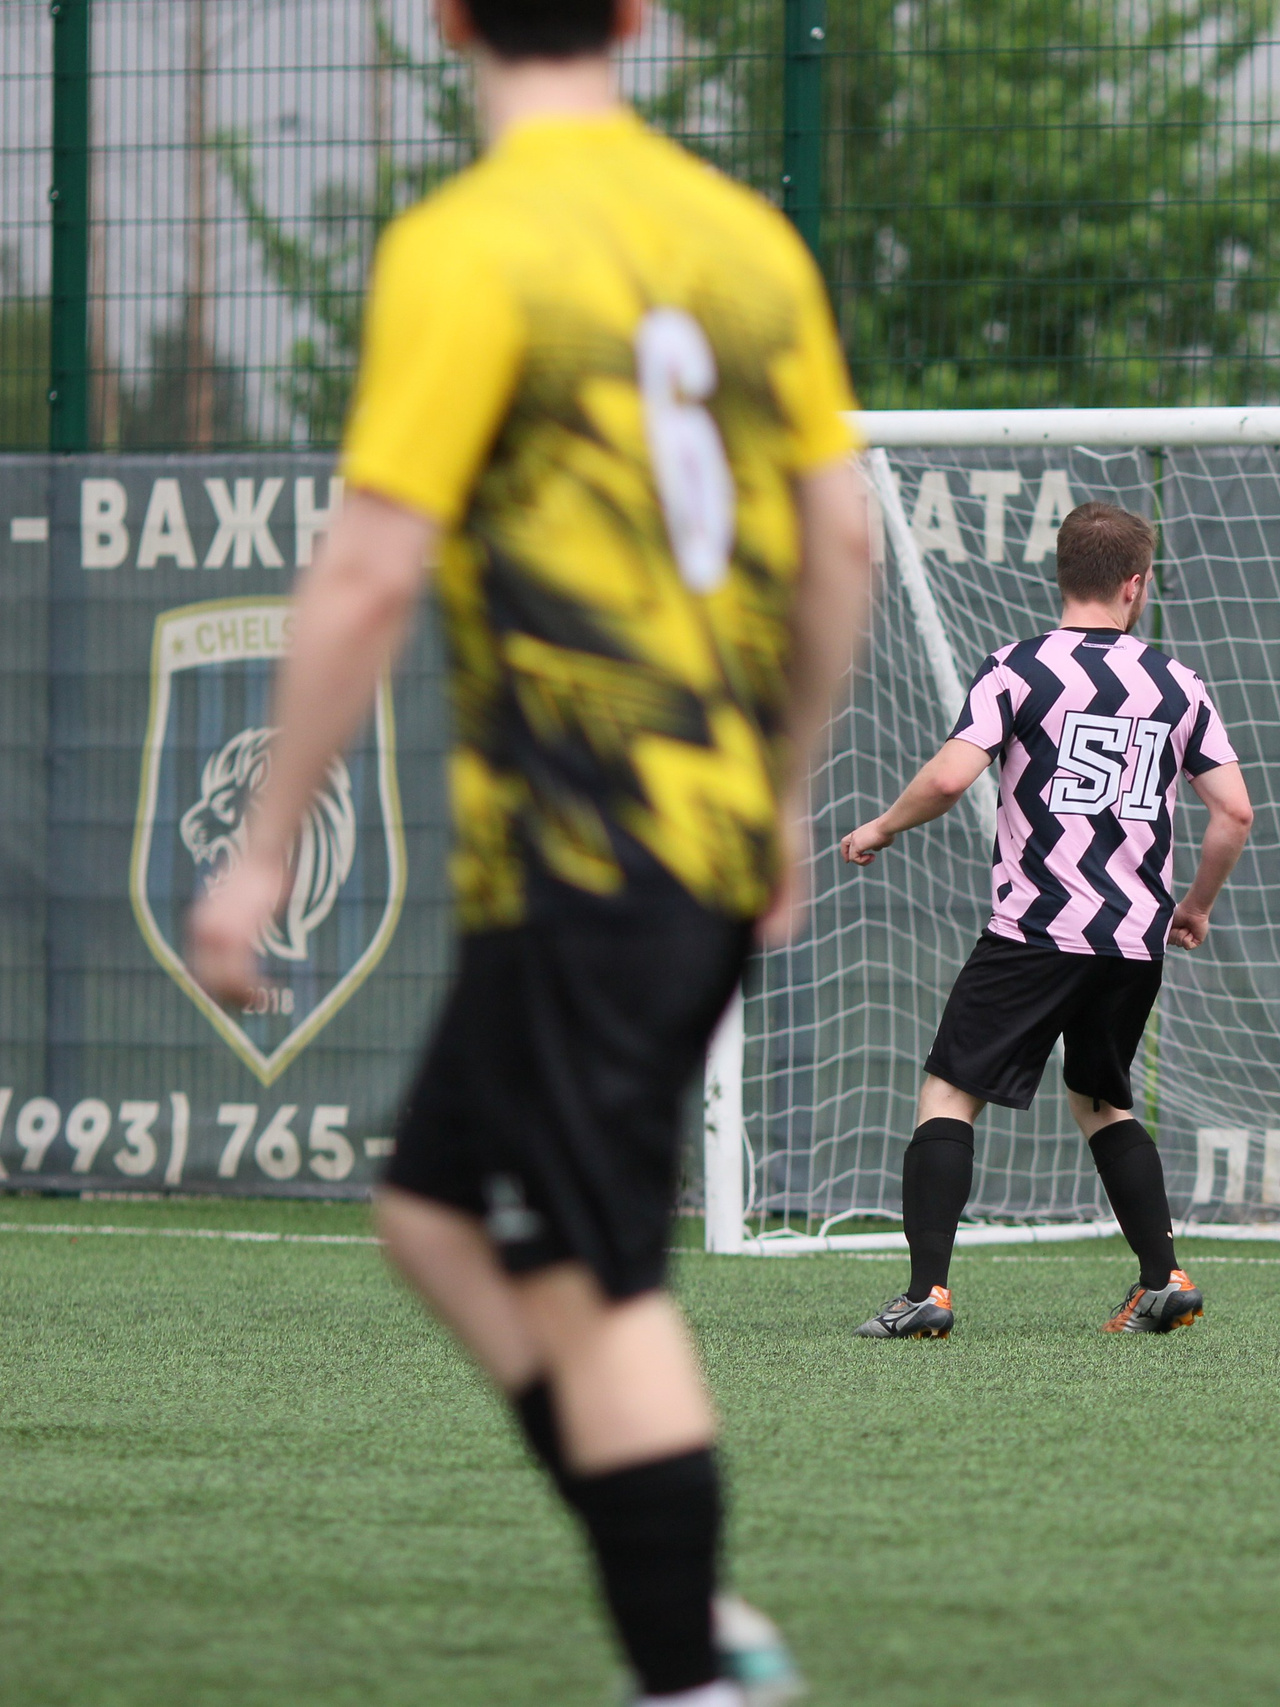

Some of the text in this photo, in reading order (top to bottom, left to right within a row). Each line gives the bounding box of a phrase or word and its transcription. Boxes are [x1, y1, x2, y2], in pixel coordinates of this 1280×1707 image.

[633, 307, 737, 594] 6
[80, 477, 348, 570] ВАЖН
[1048, 710, 1172, 822] 51
